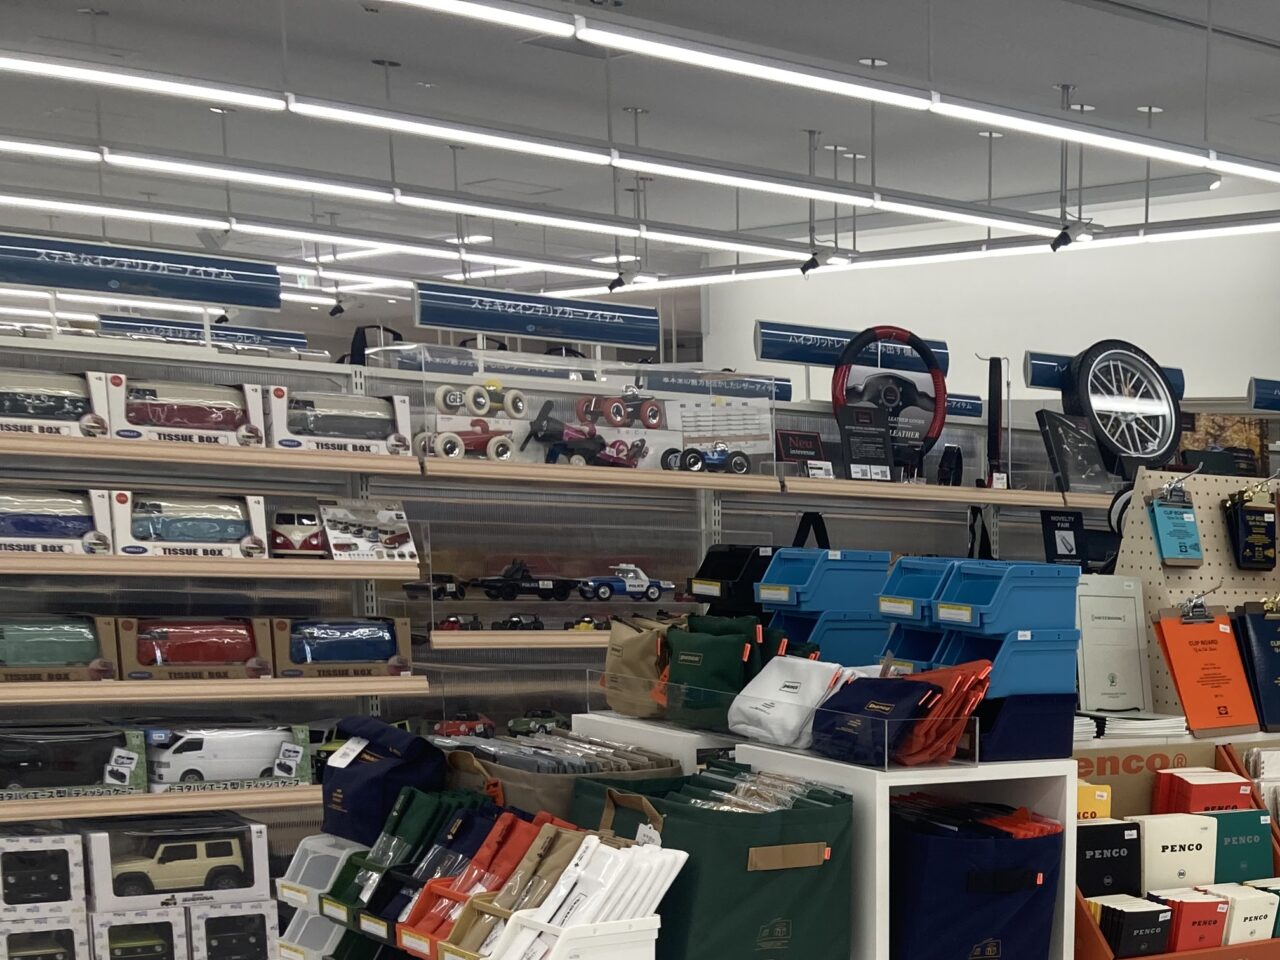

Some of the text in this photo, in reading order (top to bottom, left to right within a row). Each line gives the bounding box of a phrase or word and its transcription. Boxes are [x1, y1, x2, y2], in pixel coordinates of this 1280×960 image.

[471, 298, 624, 324] ステキなインテリアカーアイテム
[0, 423, 62, 436] ISSUE BOX
[157, 432, 220, 445] TISSUE BOX
[315, 441, 372, 454] TISSUE BOX
[0, 542, 65, 554] TISSUE BOX
[162, 547, 223, 557] TISSUE BOX
[1077, 752, 1188, 779] enco®
[1224, 835, 1260, 846] PENCO
[1161, 842, 1203, 853] PENCO
[1085, 848, 1128, 859] PENCO
[1191, 919, 1218, 927] PENCO
[1243, 913, 1269, 922] PENCO
[1133, 927, 1161, 936] PENCO
